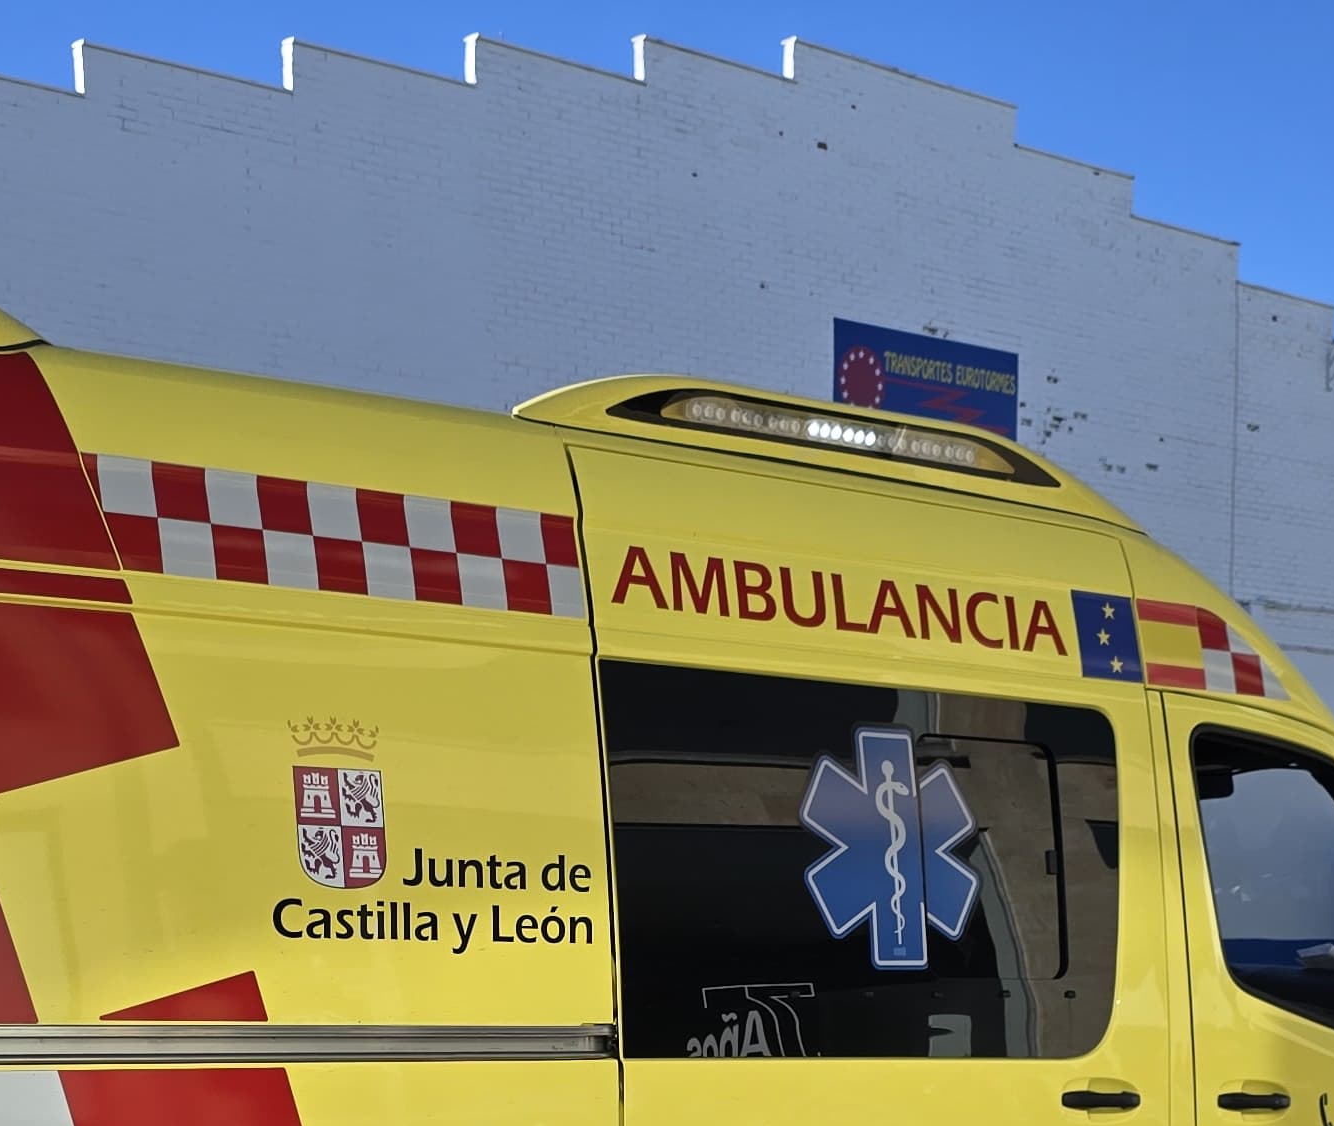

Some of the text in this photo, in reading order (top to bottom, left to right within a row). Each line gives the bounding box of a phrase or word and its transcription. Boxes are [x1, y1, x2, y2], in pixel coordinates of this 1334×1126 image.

[884, 351, 1016, 395] TRANSPORTES EUROTORMES
[611, 545, 1068, 657] AMBULANCIA
[402, 848, 592, 893] Junta de
[272, 898, 593, 954] Castilla y León
